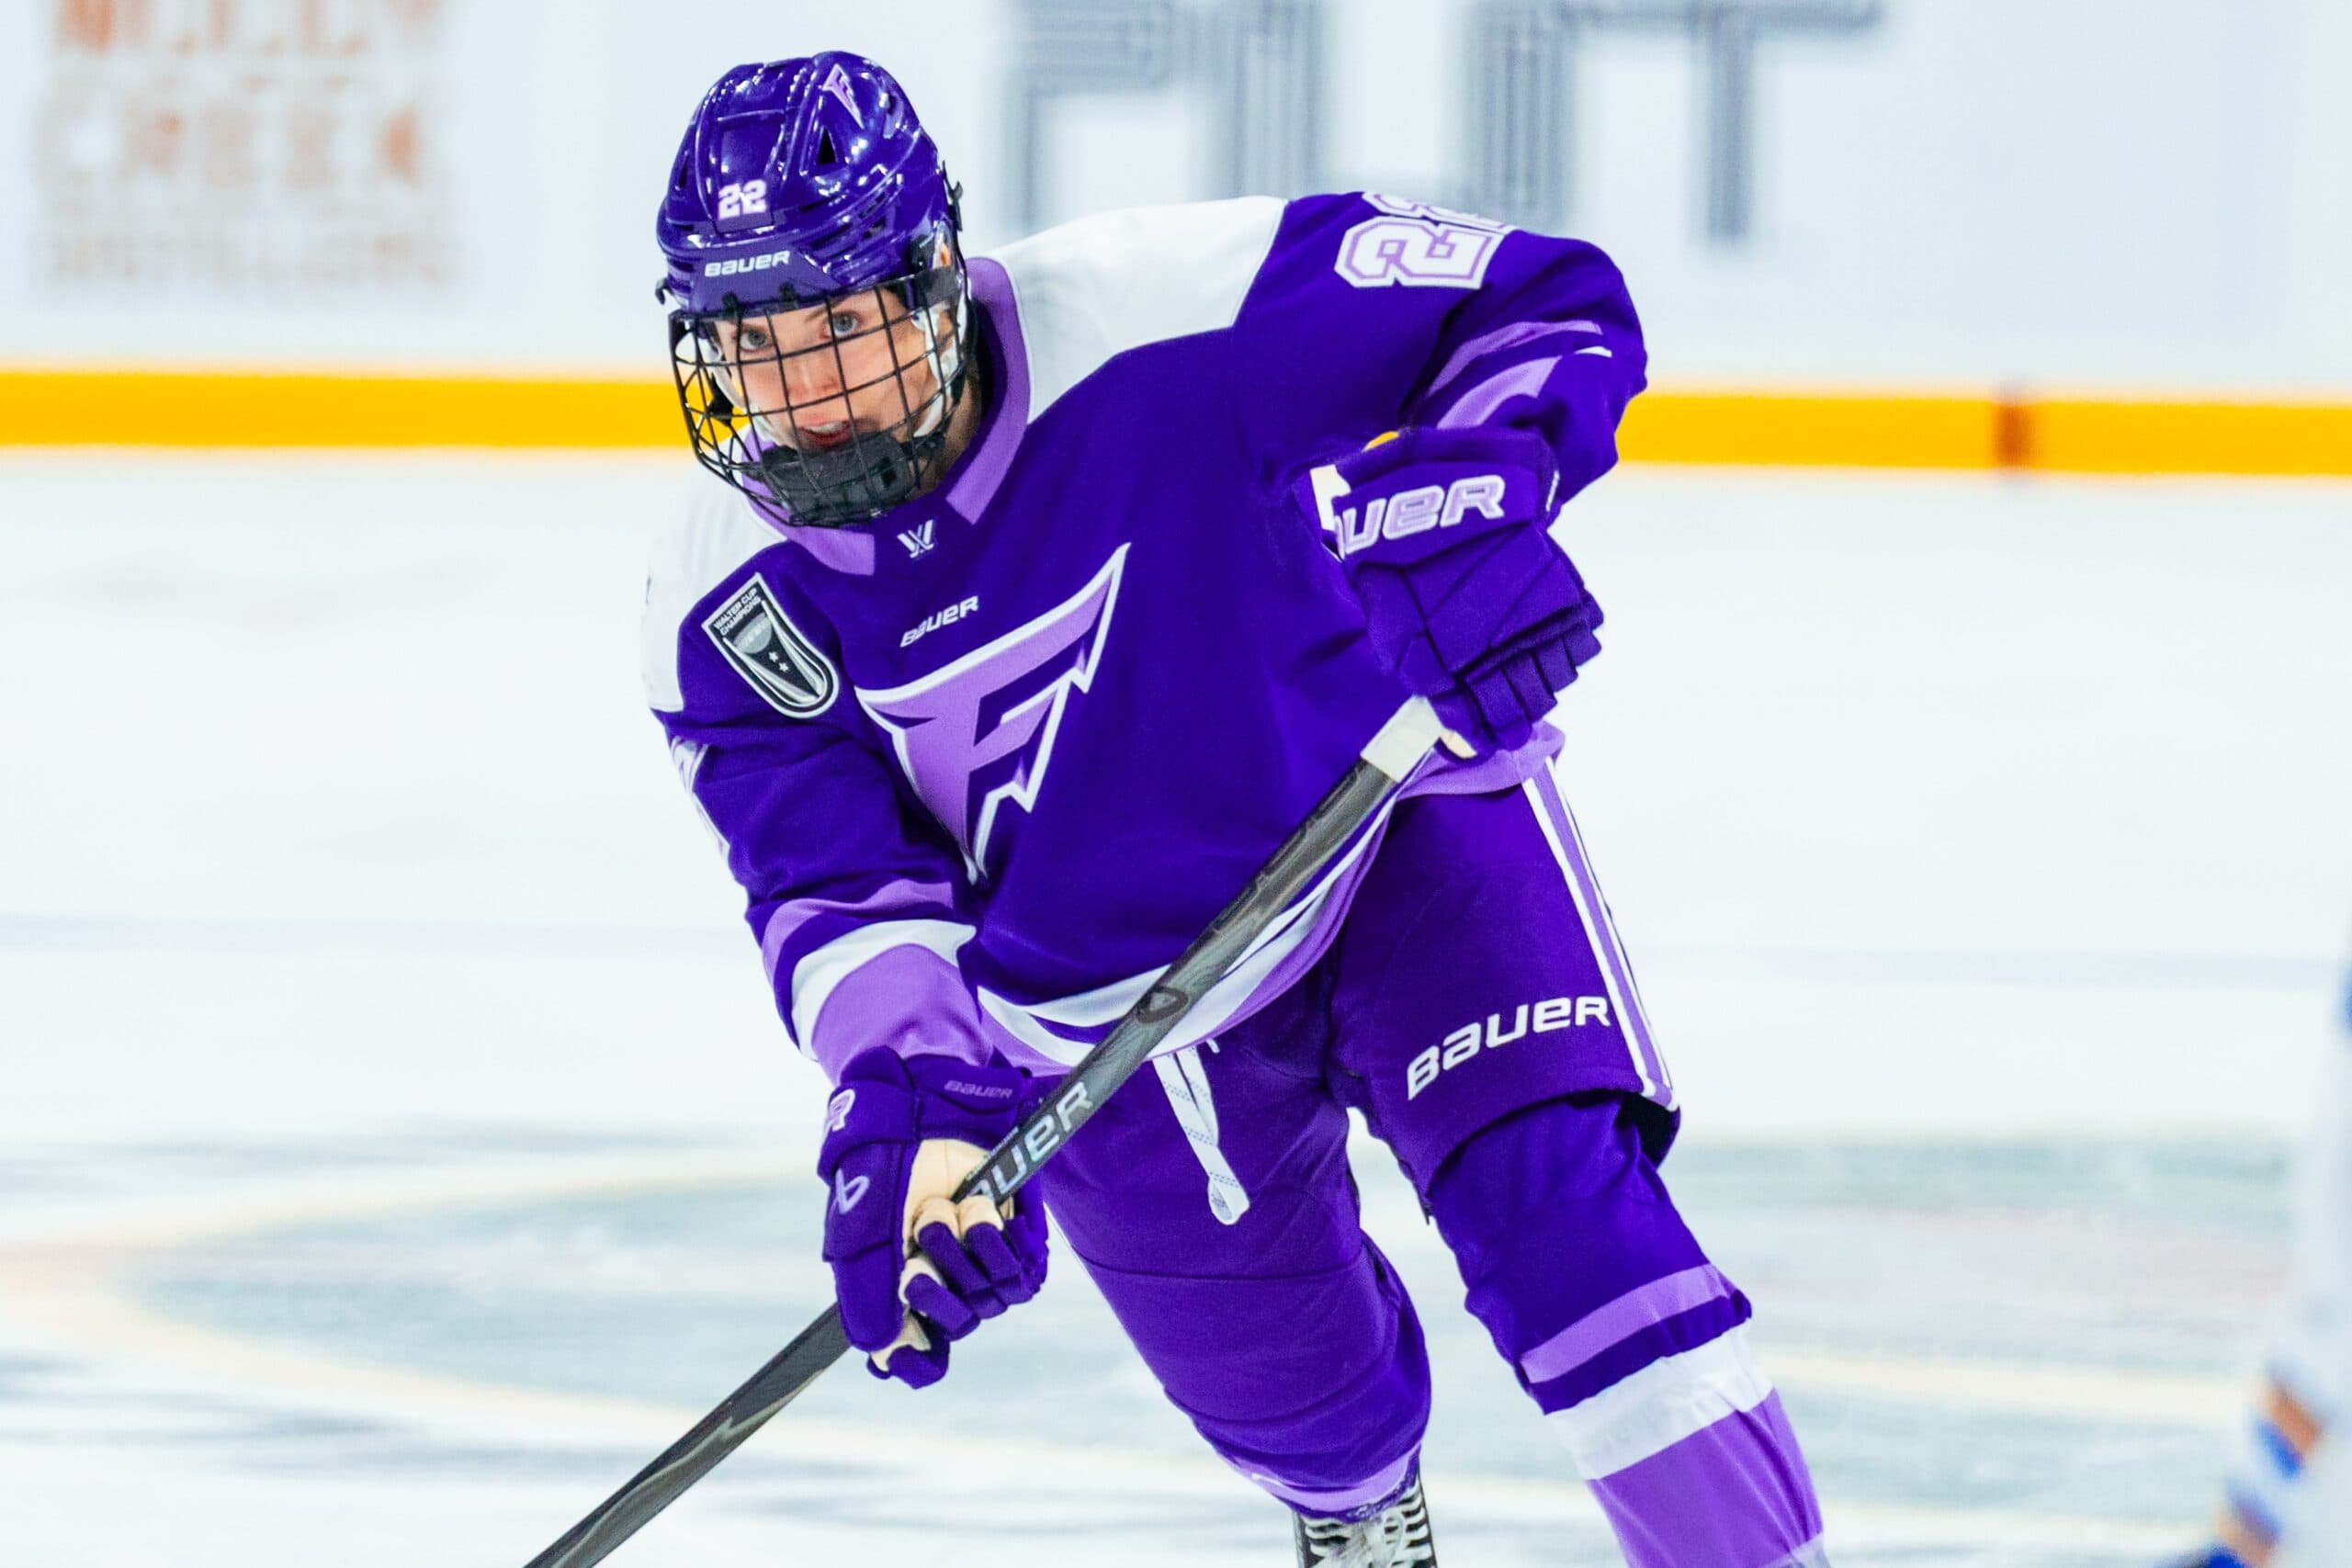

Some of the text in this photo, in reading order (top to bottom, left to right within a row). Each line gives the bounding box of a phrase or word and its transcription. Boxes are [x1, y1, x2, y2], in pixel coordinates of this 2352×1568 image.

[718, 178, 768, 220] 22
[704, 250, 791, 277] BAUER
[1334, 473, 1507, 561] UER
[713, 587, 758, 629] WALTER CUP
[719, 596, 763, 636] CHAMPIONS
[899, 595, 979, 648] BAUER
[1406, 995, 1611, 1101] BAUER
[944, 1079, 1013, 1100] BAUER
